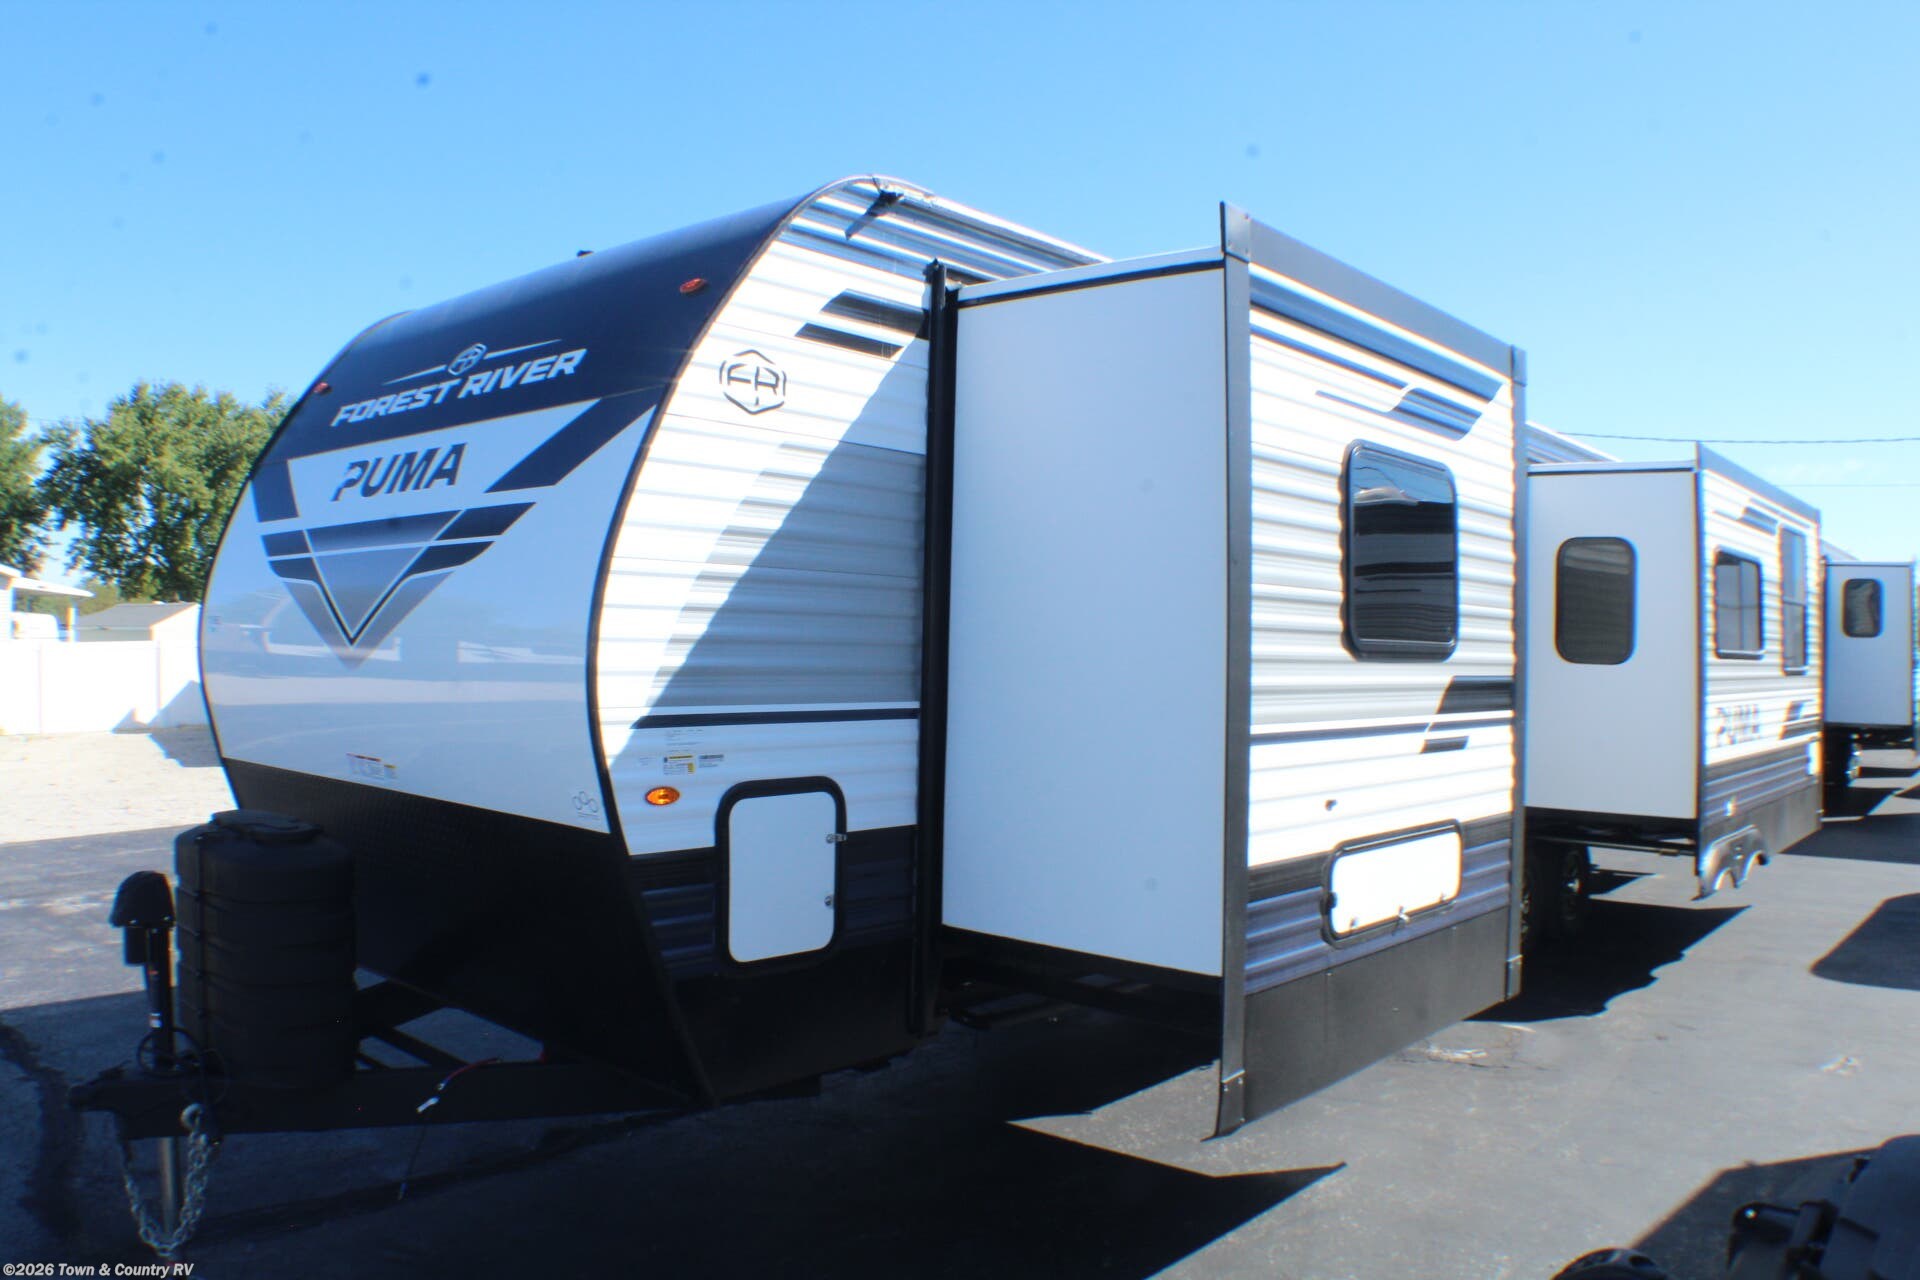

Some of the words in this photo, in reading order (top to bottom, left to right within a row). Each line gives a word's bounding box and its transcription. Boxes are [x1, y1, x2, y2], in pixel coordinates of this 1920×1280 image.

[330, 379, 463, 427] FOREST
[457, 348, 588, 399] RIVER
[331, 442, 468, 502] PUMA
